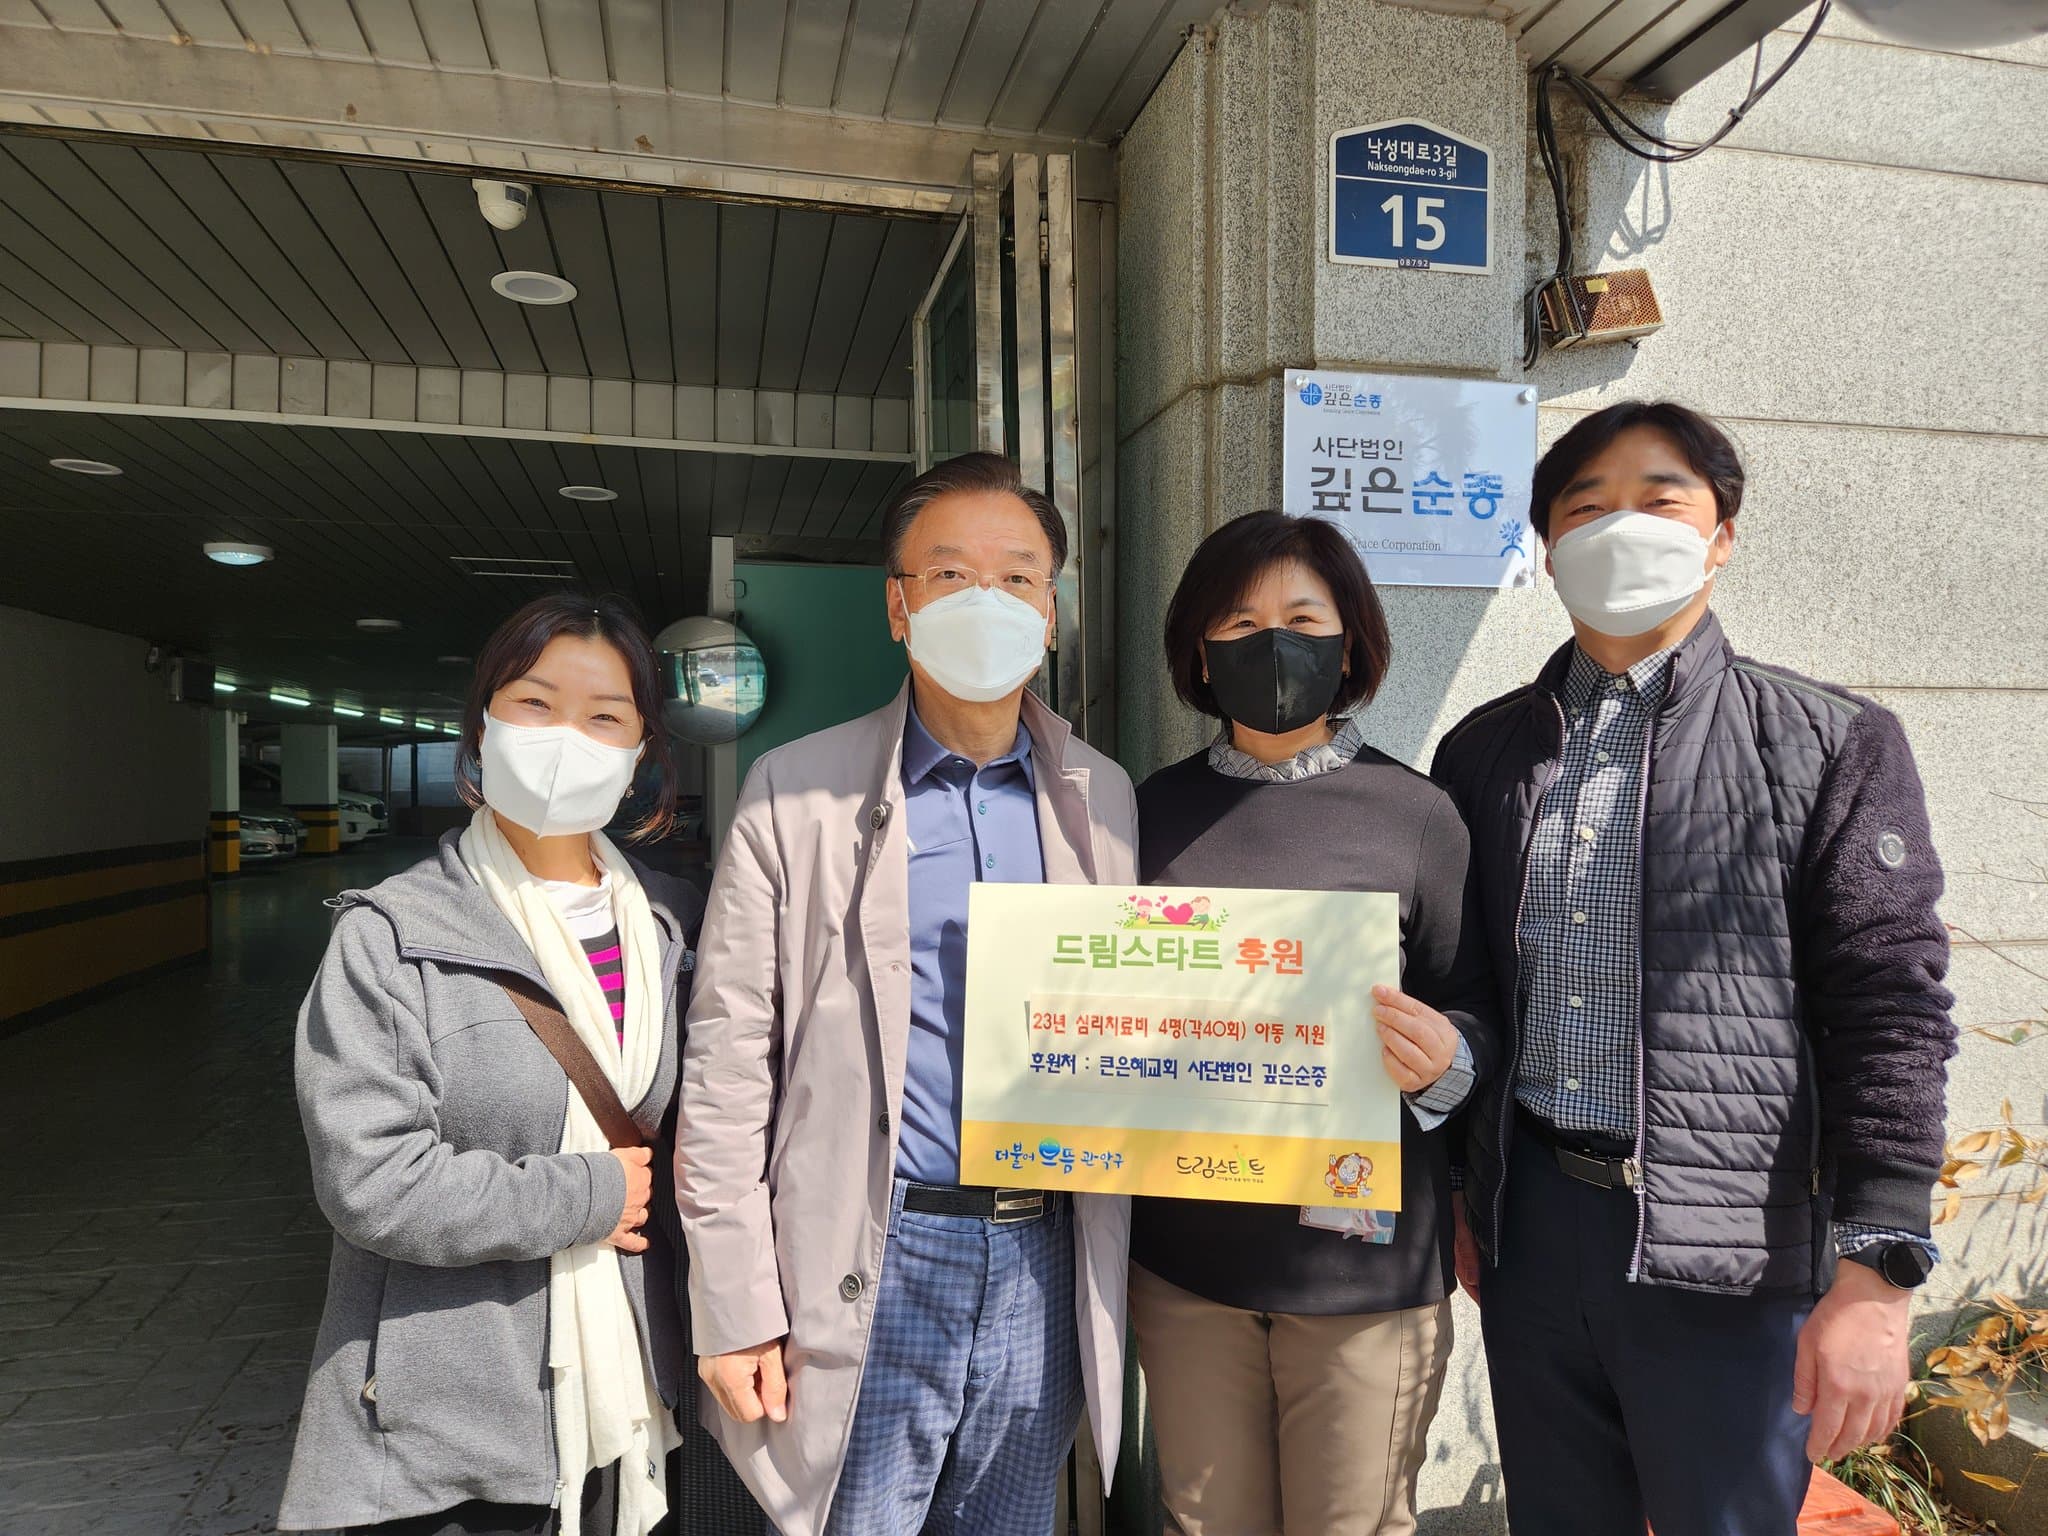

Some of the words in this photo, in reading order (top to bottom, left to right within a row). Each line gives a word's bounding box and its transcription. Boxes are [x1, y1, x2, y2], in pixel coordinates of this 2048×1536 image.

[1368, 137, 1457, 166] 낙성대로3길
[1367, 160, 1437, 177] Nakseongdae-ro
[1438, 167, 1457, 180] 3-gil
[1380, 194, 1446, 251] 15
[1399, 258, 1429, 268] 08792
[1324, 391, 1382, 409] 깊은순종
[1312, 436, 1403, 461] 사단법인
[1311, 466, 1504, 519] 깊은순종
[1381, 538, 1441, 553] Corporation
[1053, 934, 1222, 971] 드림스타트
[1235, 938, 1303, 975] 후원
[1033, 1012, 1065, 1034] 23년
[1076, 1014, 1148, 1038] 심리치료비
[1158, 1018, 1246, 1041] 4명(각40회)
[1254, 1022, 1284, 1044] 아동
[1295, 1024, 1325, 1045] 지원
[1030, 1052, 1076, 1075] 후원처
[1100, 1055, 1178, 1080] 큰은혜교회
[1188, 1059, 1253, 1083] 사단법인
[1262, 1063, 1327, 1088] 깊은순종
[995, 1142, 1035, 1169] 더불어
[1081, 1150, 1124, 1170] 관악구
